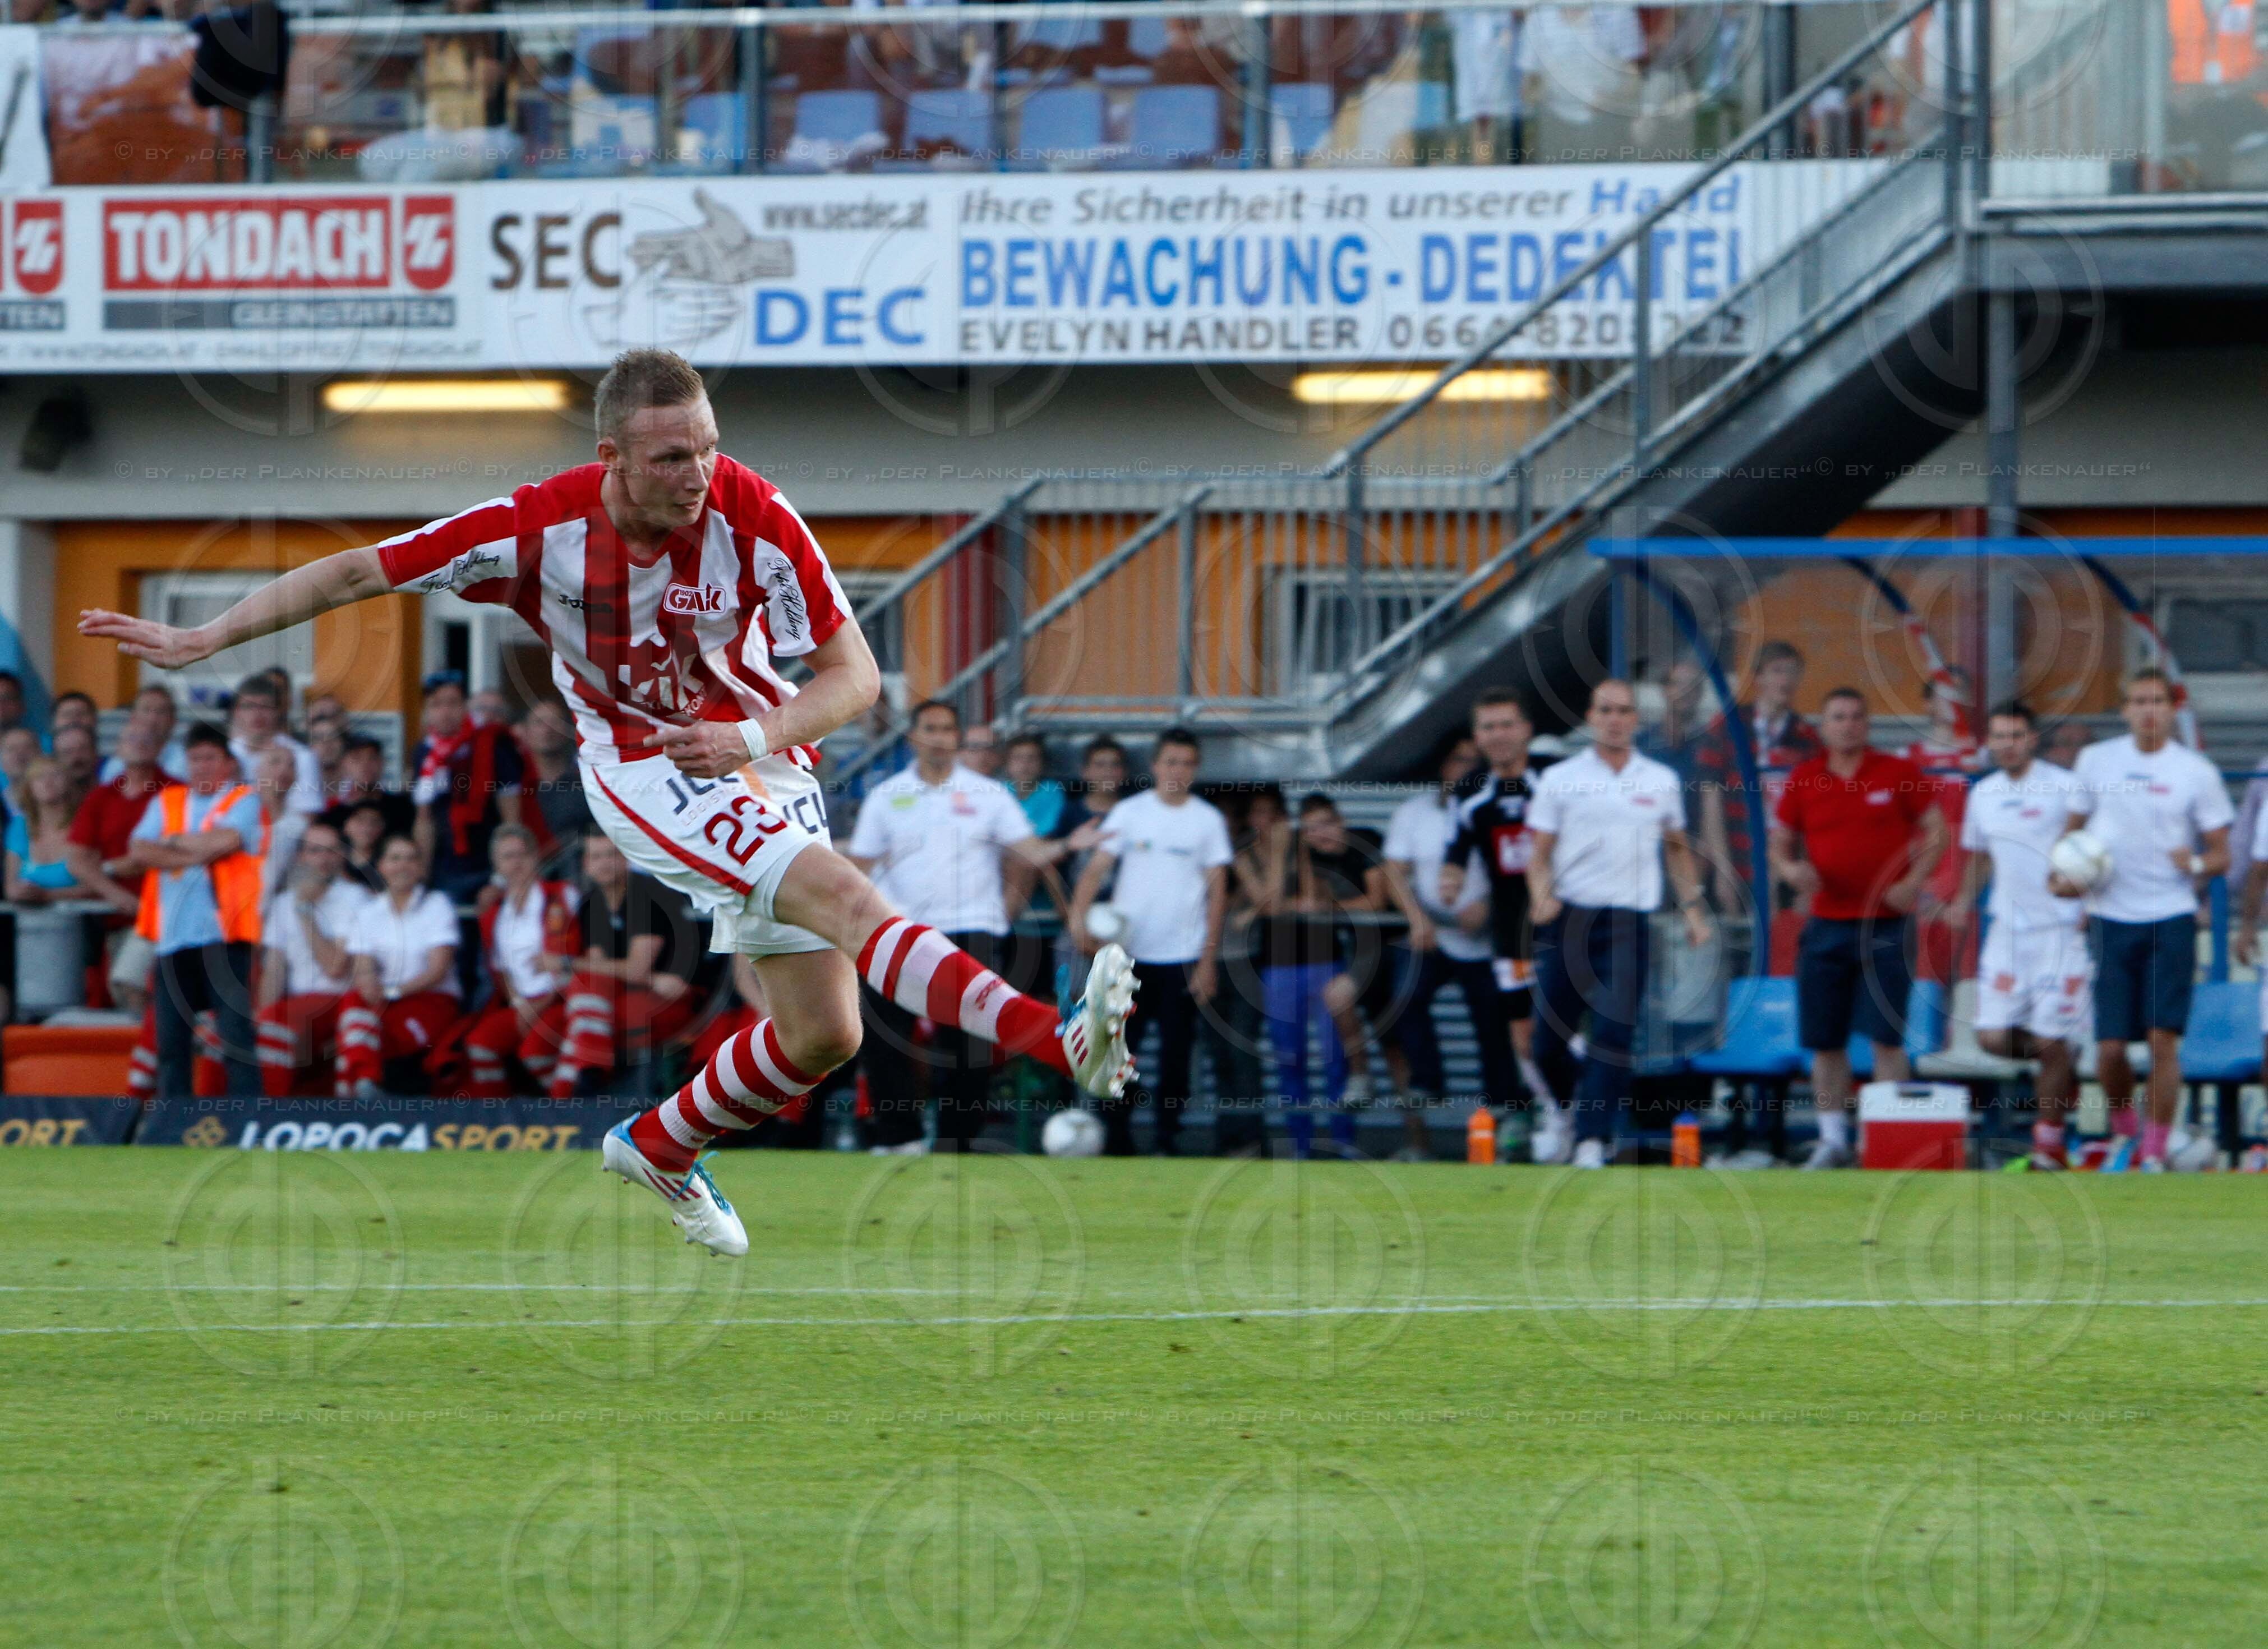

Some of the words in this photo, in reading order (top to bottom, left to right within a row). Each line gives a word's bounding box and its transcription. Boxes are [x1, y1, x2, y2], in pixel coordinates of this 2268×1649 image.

[961, 188, 1052, 223] Ihre
[1073, 186, 1306, 223] Sicherheit
[1325, 185, 1367, 219] in
[1389, 189, 1574, 219] unserer
[109, 210, 385, 282] TONDACH
[491, 213, 623, 290] SEC
[962, 234, 1370, 308] BEWACHUNG
[755, 285, 927, 346] DEC
[960, 317, 1130, 352] EVELYN
[1144, 316, 1359, 351] HANDLER
[704, 795, 787, 867] 23
